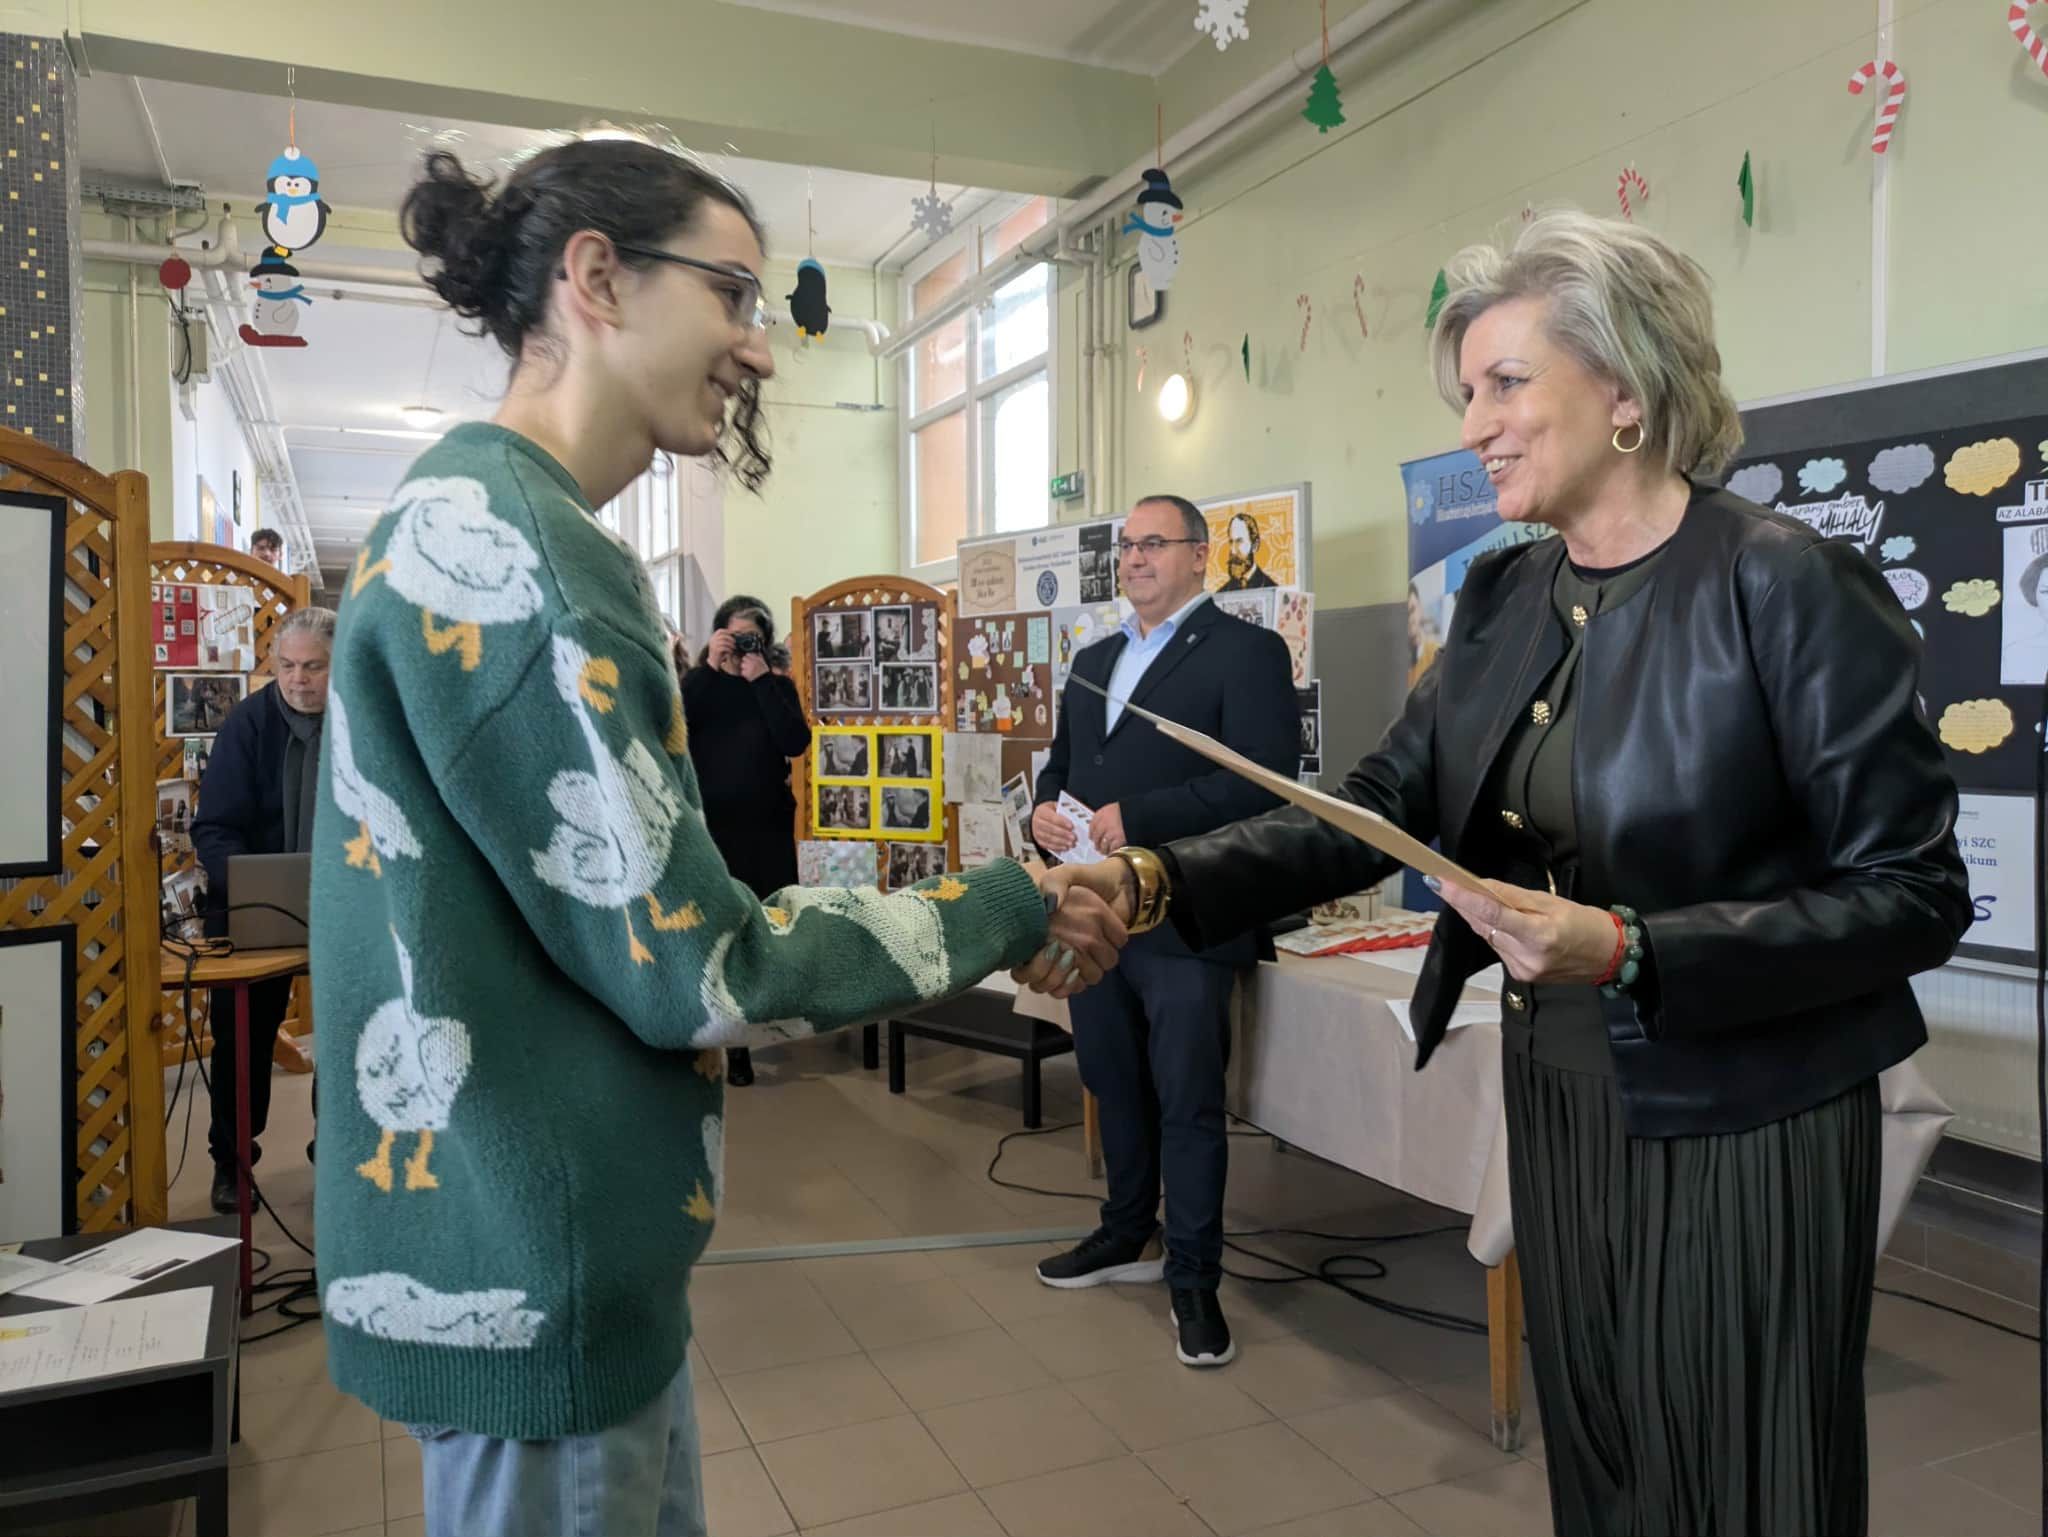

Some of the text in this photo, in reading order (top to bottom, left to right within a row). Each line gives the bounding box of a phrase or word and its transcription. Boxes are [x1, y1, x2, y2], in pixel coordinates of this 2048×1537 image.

[2028, 481, 2048, 501] T
[1971, 836, 1996, 849] SZC
[1962, 854, 1998, 867] ikum
